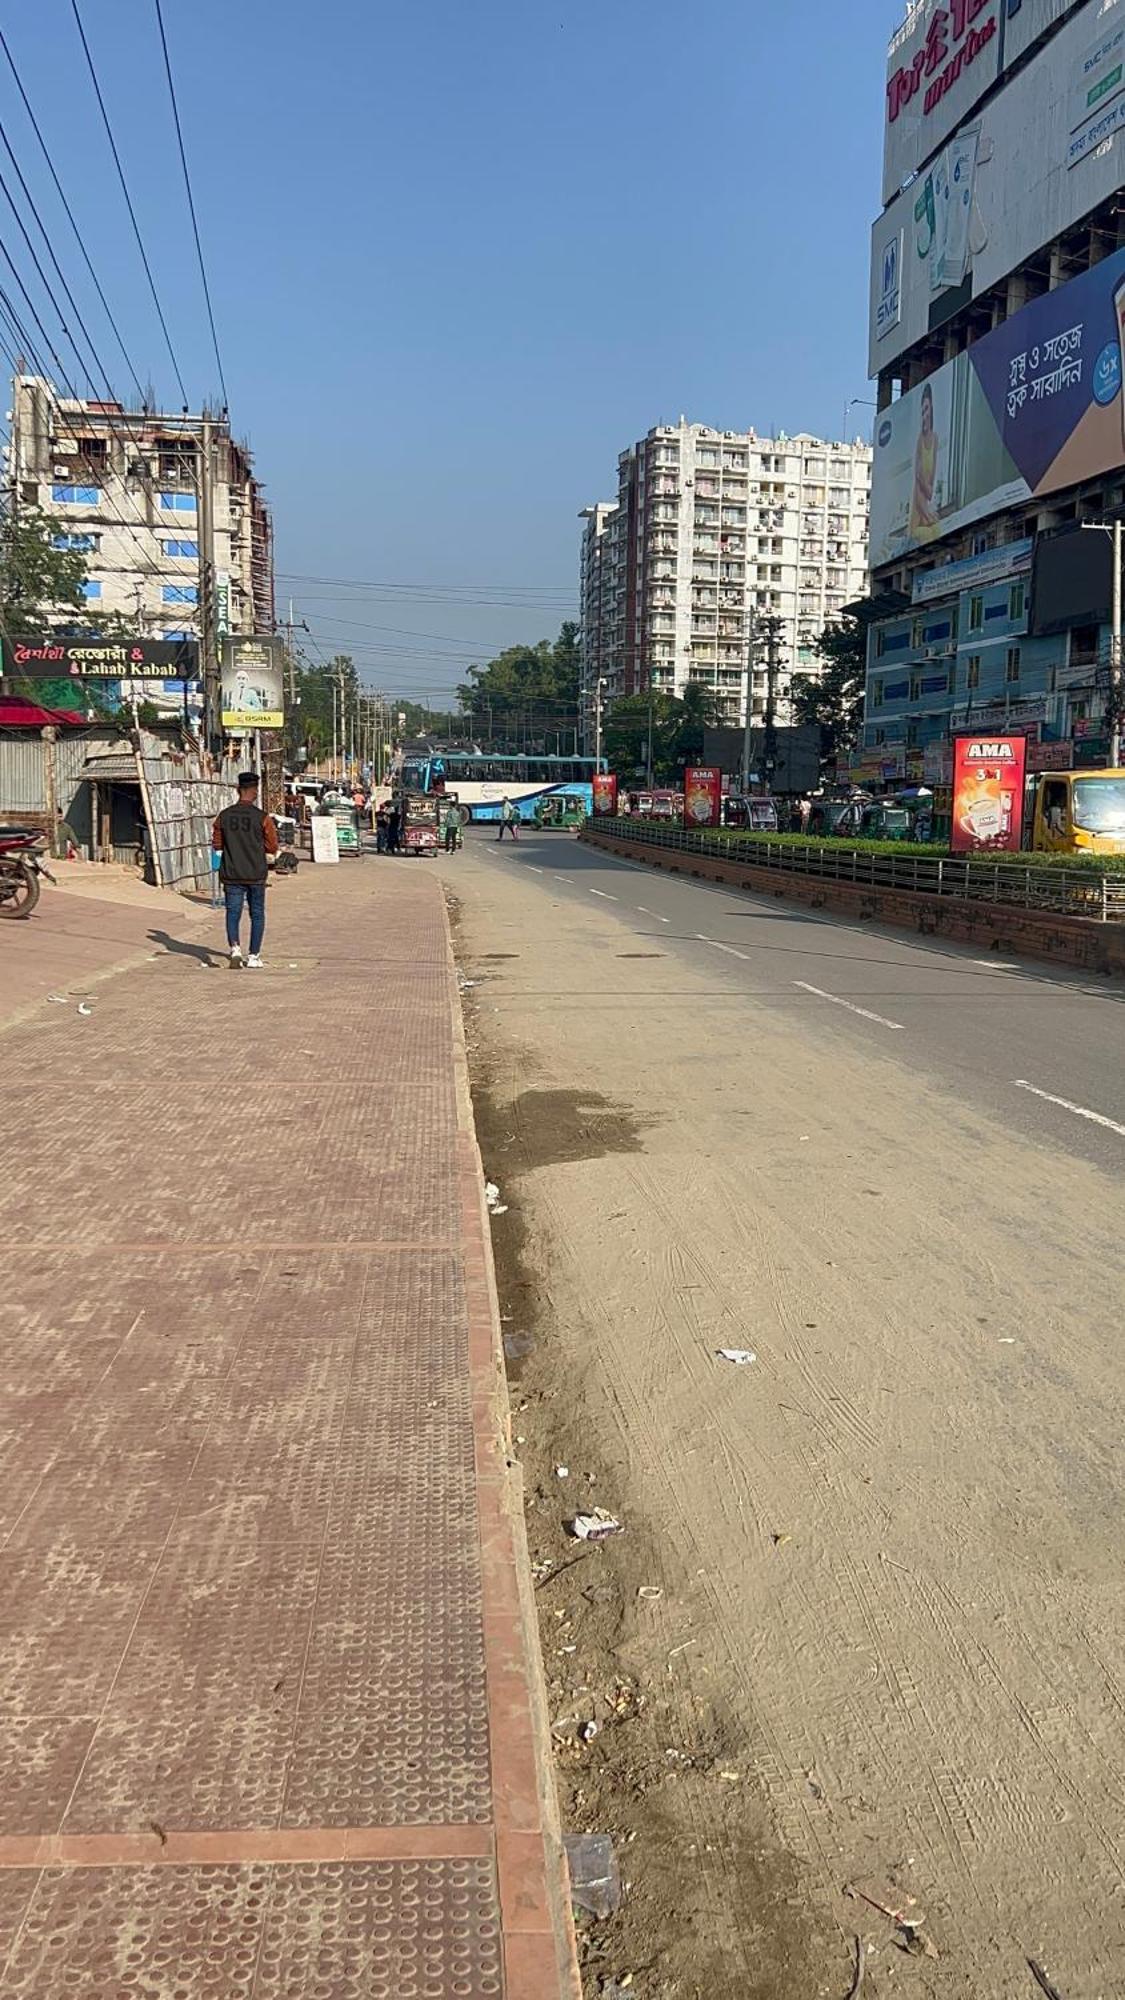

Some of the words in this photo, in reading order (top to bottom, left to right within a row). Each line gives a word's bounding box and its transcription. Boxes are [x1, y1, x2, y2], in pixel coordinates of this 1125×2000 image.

[1009, 352, 1028, 387] সুস্থ
[1029, 346, 1040, 370] ও
[1043, 323, 1084, 362] সতেজ
[1007, 384, 1029, 418] ত্বক
[1030, 356, 1083, 400] সারাদিন
[13, 643, 65, 664] বৈশাখী
[130, 647, 144, 661] &
[81, 663, 126, 676] Lahab
[130, 663, 177, 677] Kabab
[968, 744, 1013, 758] AMA
